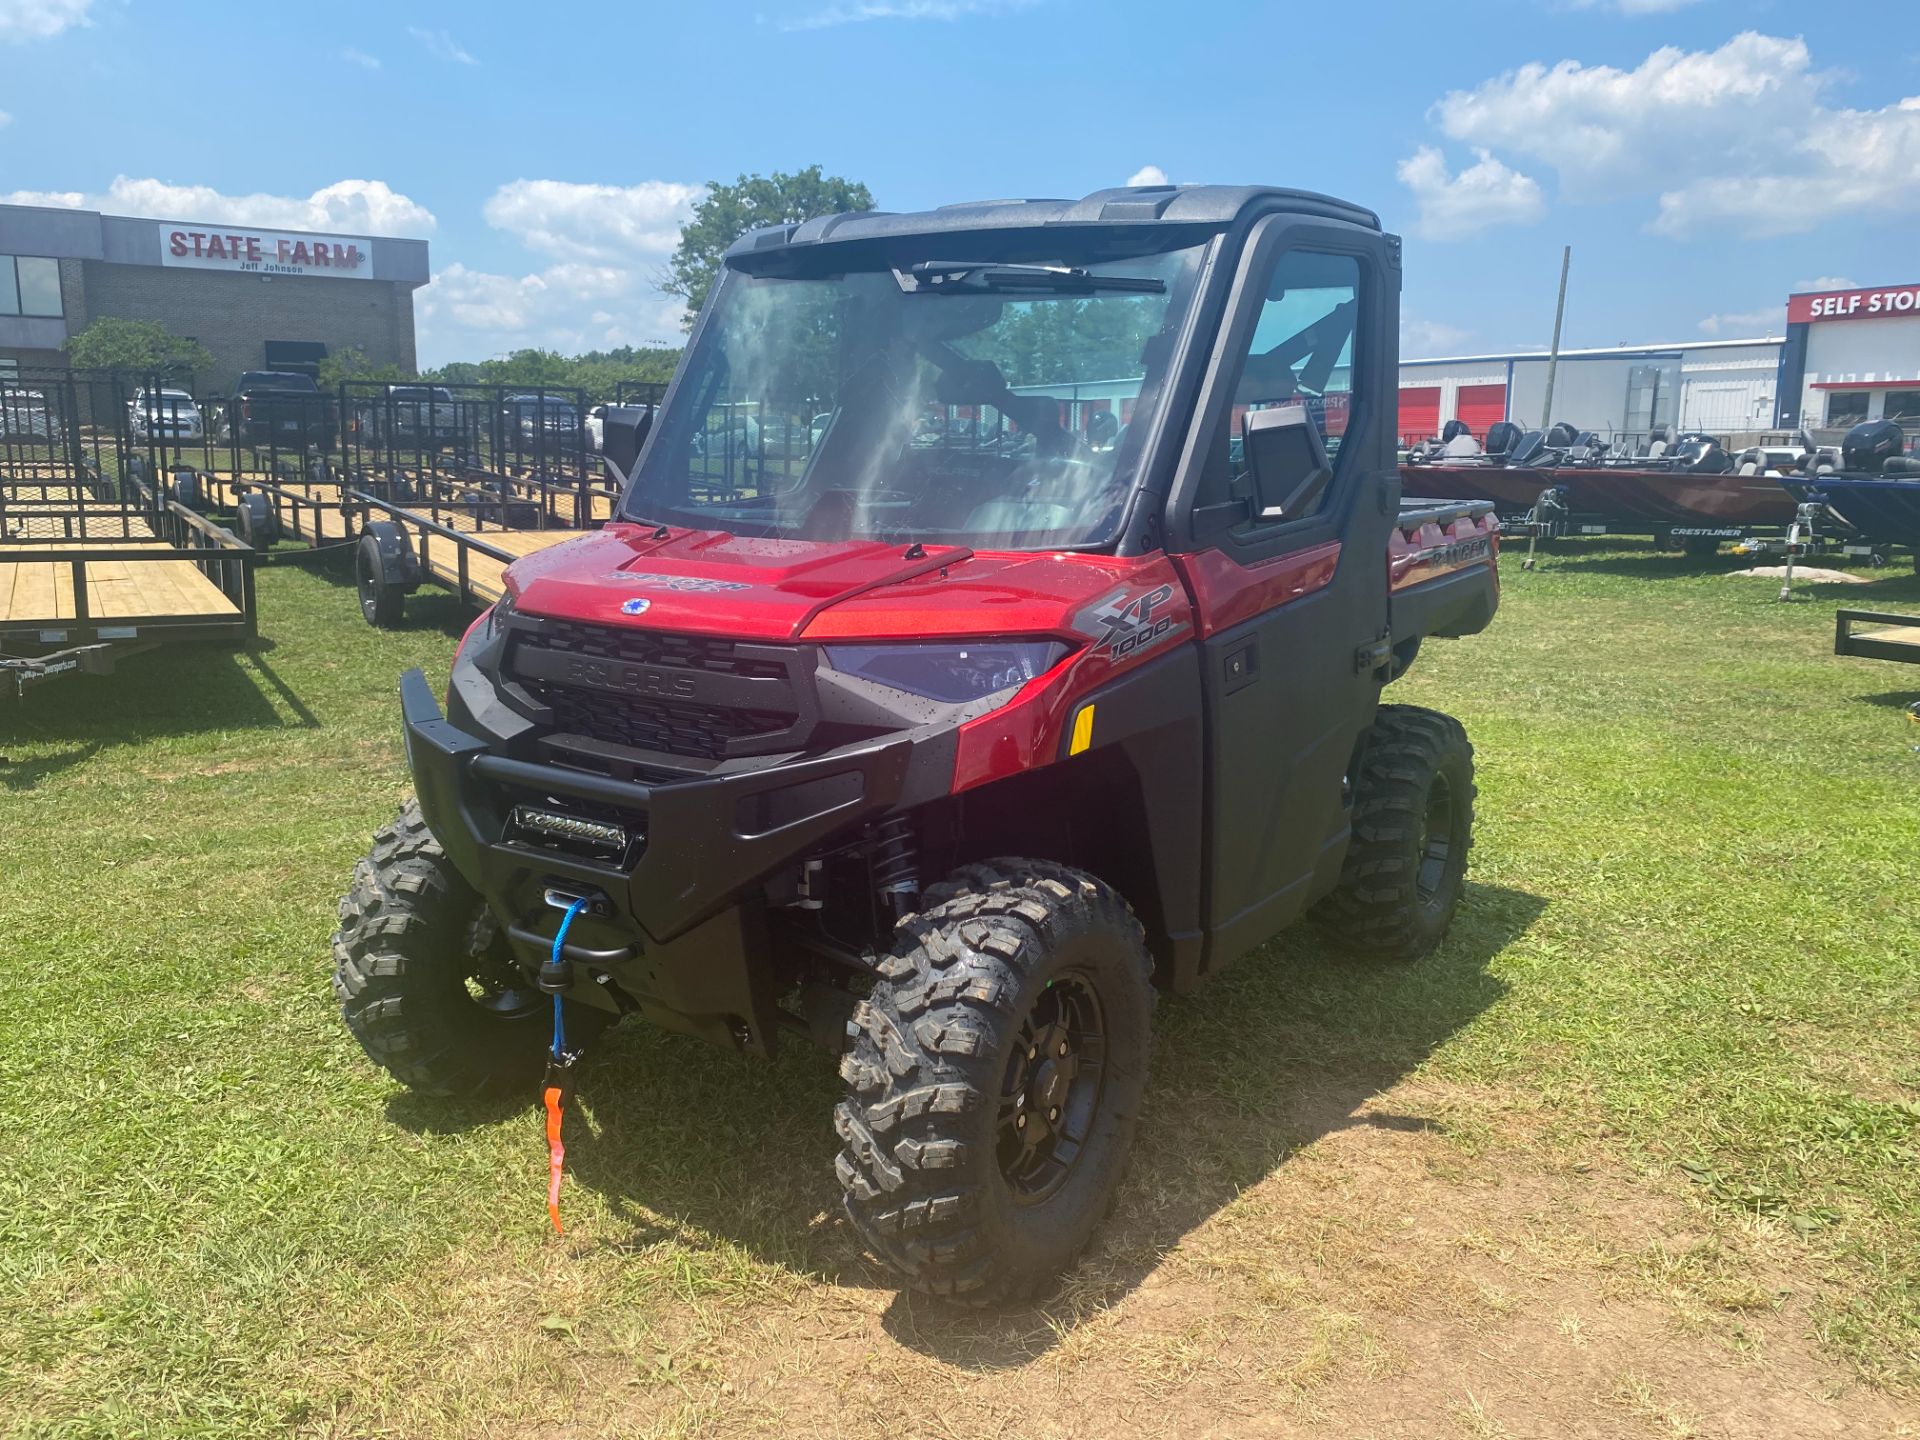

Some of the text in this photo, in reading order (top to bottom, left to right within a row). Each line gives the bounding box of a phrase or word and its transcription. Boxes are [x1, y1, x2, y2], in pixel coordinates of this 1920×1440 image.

[170, 231, 263, 262] STATE
[239, 261, 304, 274] Jeff Johnson
[1809, 295, 1862, 317] SELF
[1670, 528, 1742, 537] CRESTLINER
[1431, 538, 1488, 567] RANGER
[1089, 583, 1175, 652] XP
[1110, 615, 1172, 662] 1000
[567, 657, 697, 699] POLARIS
